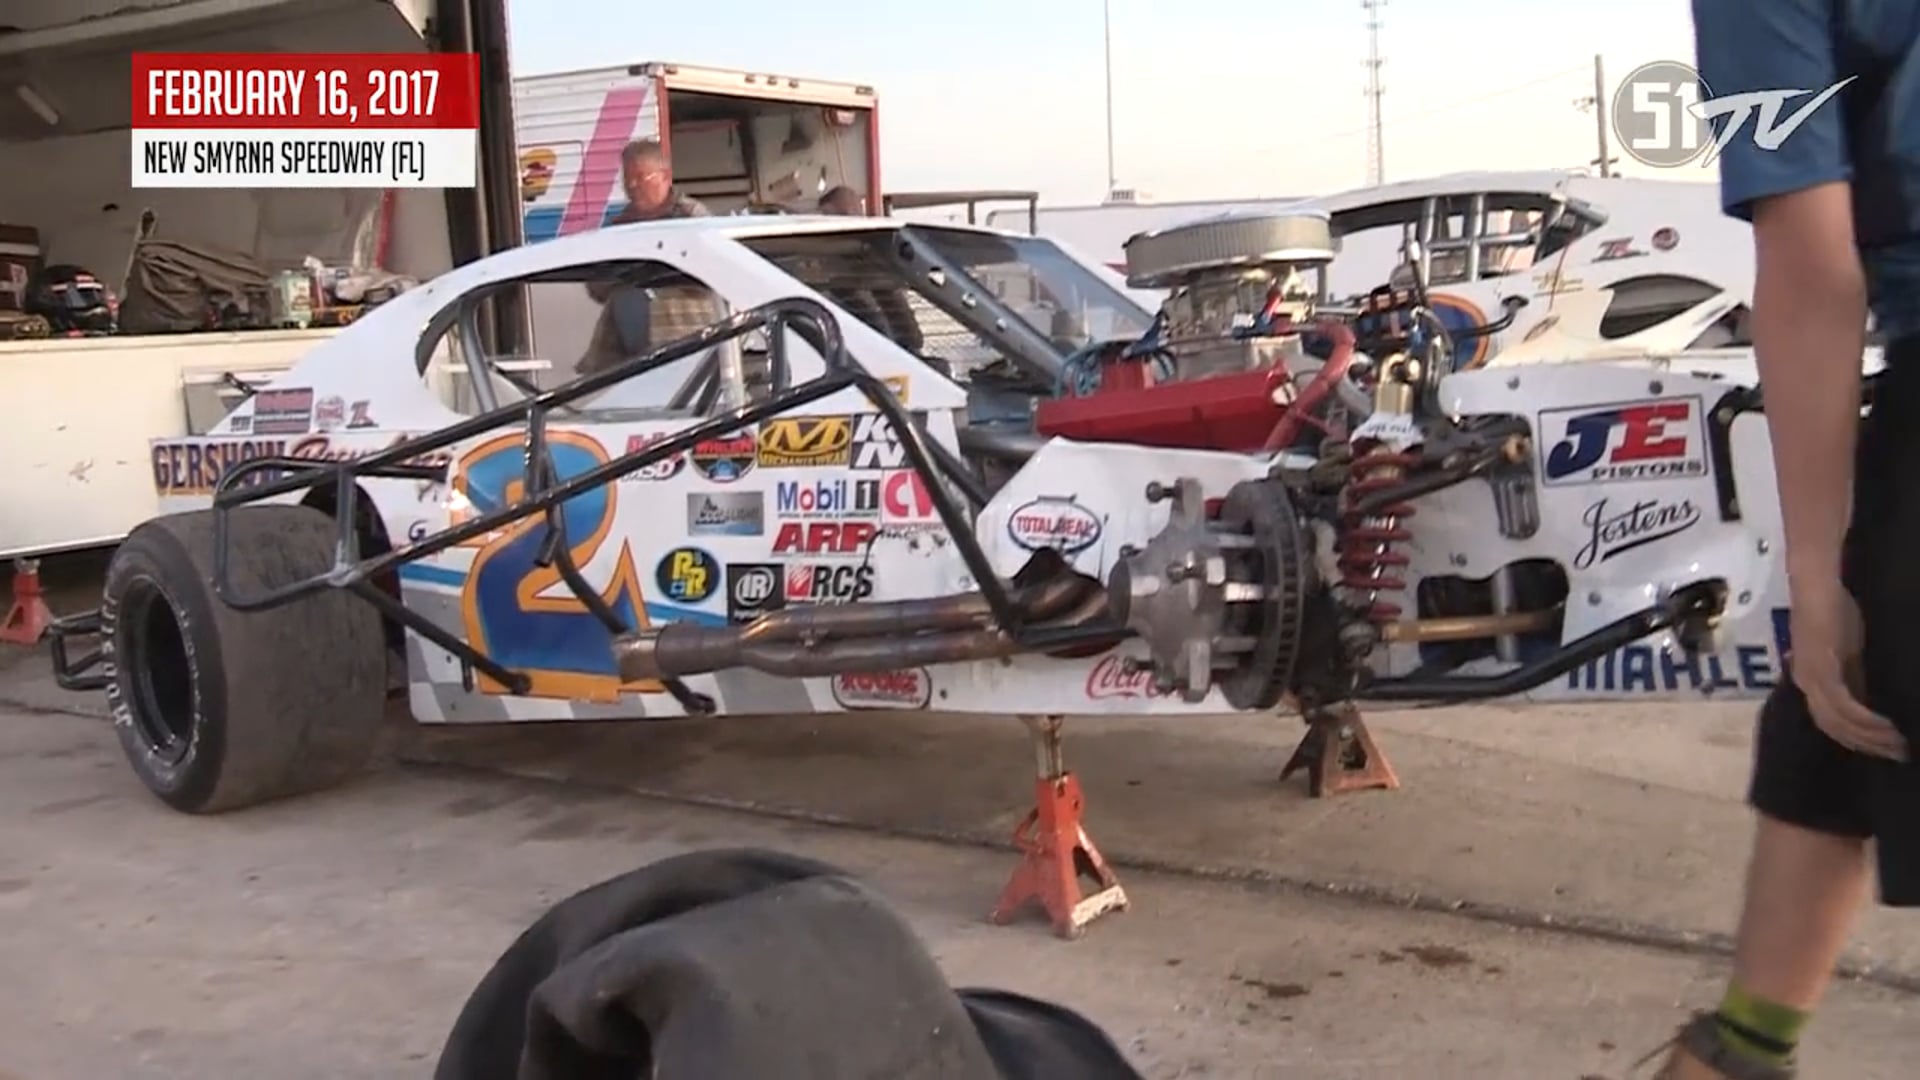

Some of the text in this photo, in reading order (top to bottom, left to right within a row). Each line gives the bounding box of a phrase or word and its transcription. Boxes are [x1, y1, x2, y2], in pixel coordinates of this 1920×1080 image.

[1547, 403, 1690, 479] JE
[1592, 462, 1702, 479] PISTONS
[777, 480, 846, 512] Mobil
[773, 523, 878, 553] ARP
[1016, 515, 1053, 535] TOTAL
[1574, 496, 1701, 570] Jostens
[455, 430, 662, 703] 2
[811, 566, 874, 598] RCS
